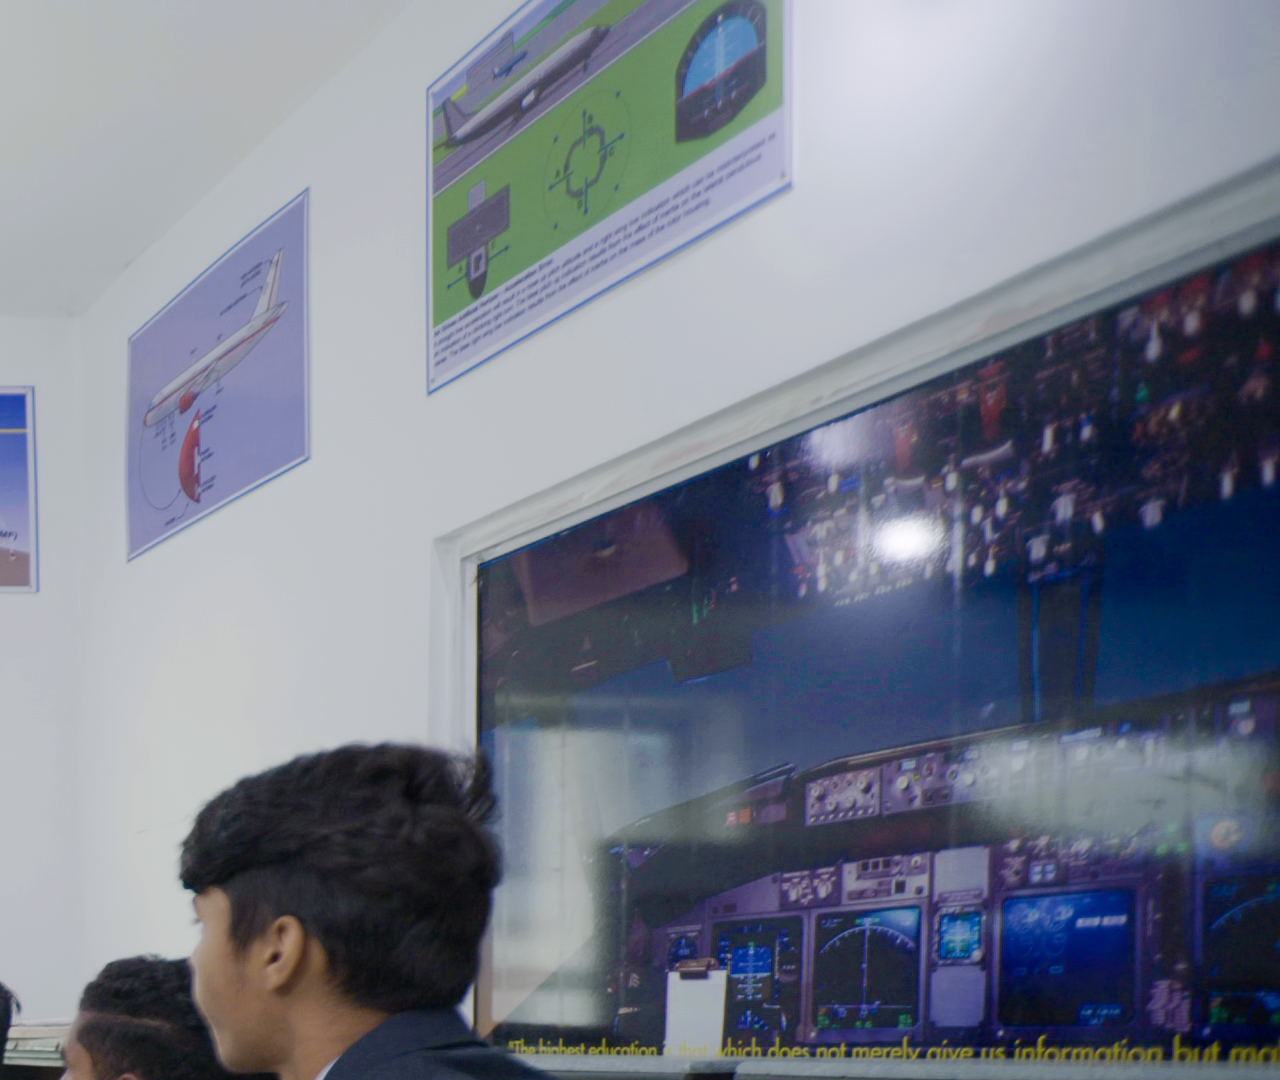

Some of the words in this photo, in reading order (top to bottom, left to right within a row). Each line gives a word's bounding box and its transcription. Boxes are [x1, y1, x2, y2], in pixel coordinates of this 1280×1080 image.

[589, 1037, 658, 1055] education
[768, 1037, 811, 1058] does
[817, 1042, 848, 1058] not
[852, 1036, 921, 1059] merely
[981, 1046, 1007, 1060] us
[1014, 1034, 1164, 1062] information
[1173, 1034, 1221, 1062] but
